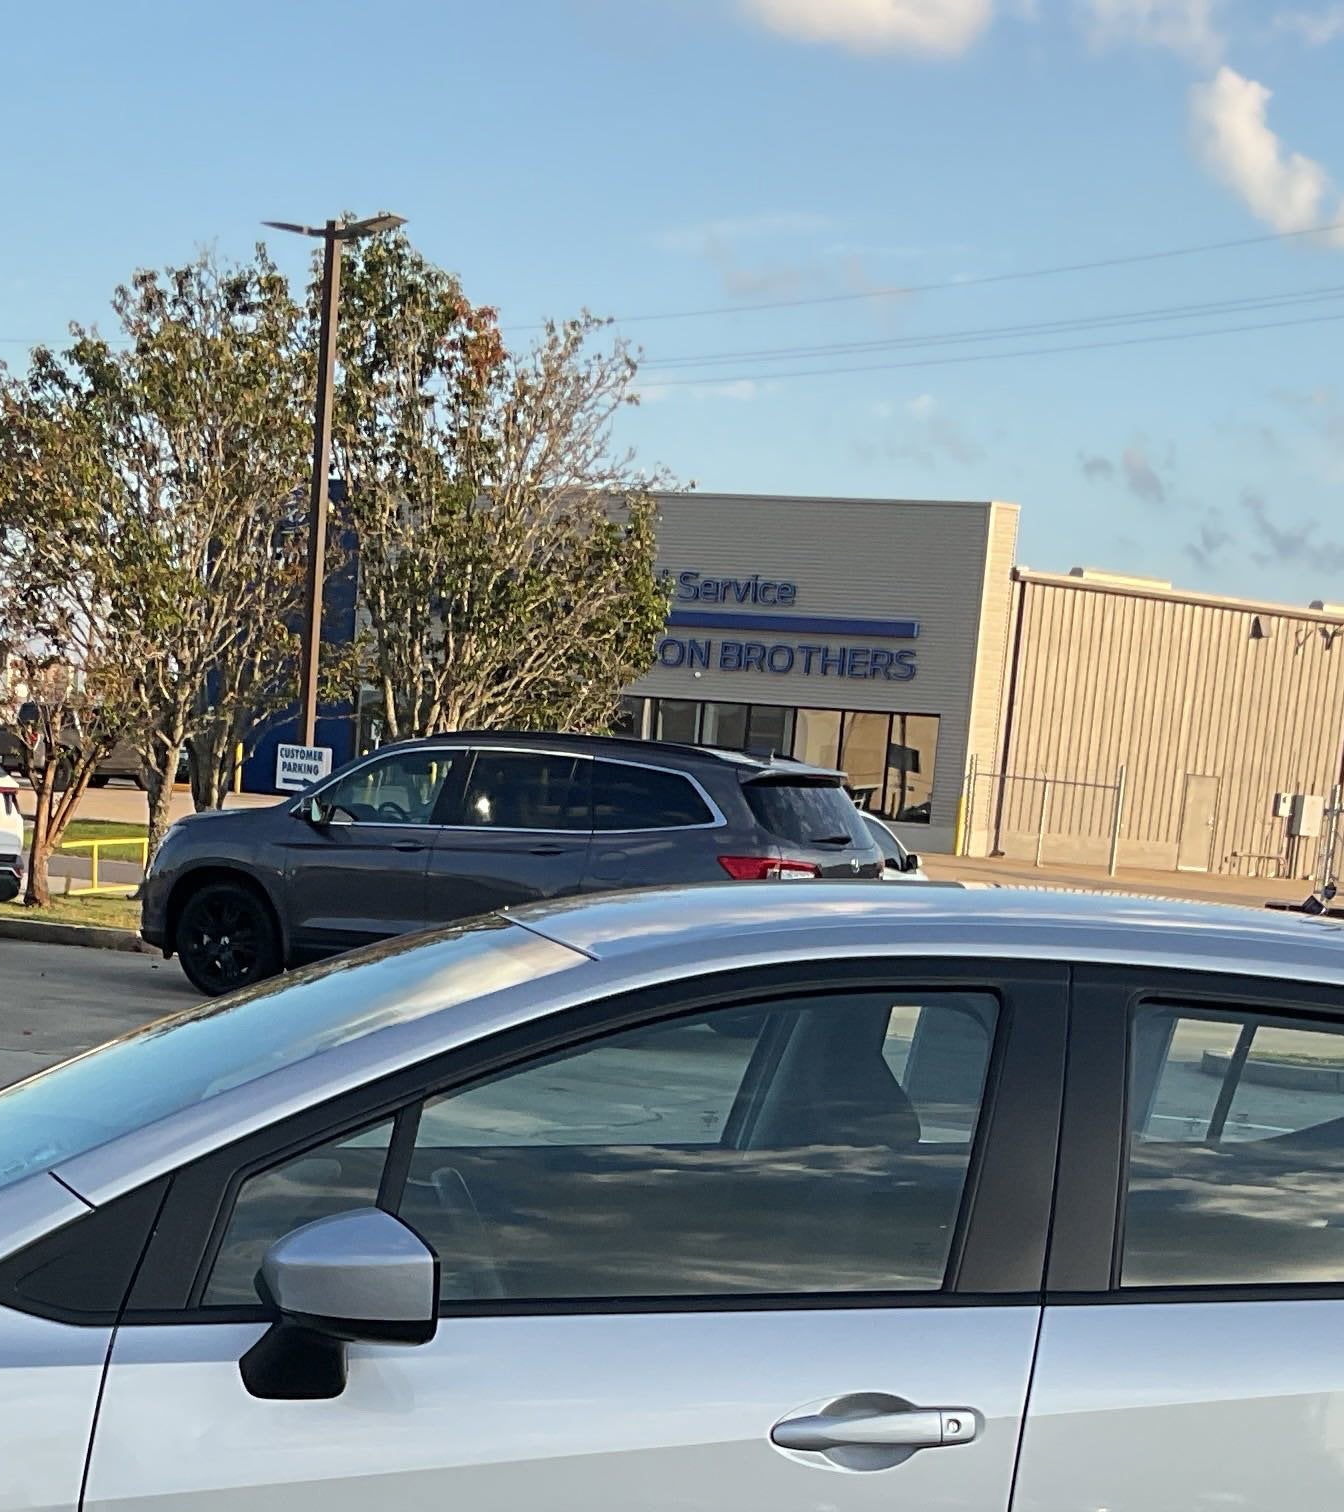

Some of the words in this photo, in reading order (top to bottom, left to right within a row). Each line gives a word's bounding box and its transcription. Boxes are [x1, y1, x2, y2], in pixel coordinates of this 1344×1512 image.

[678, 571, 798, 607] Service
[718, 640, 917, 682] BROTHERS
[279, 747, 324, 762] CUSTOMER
[281, 761, 320, 776] PARKING
